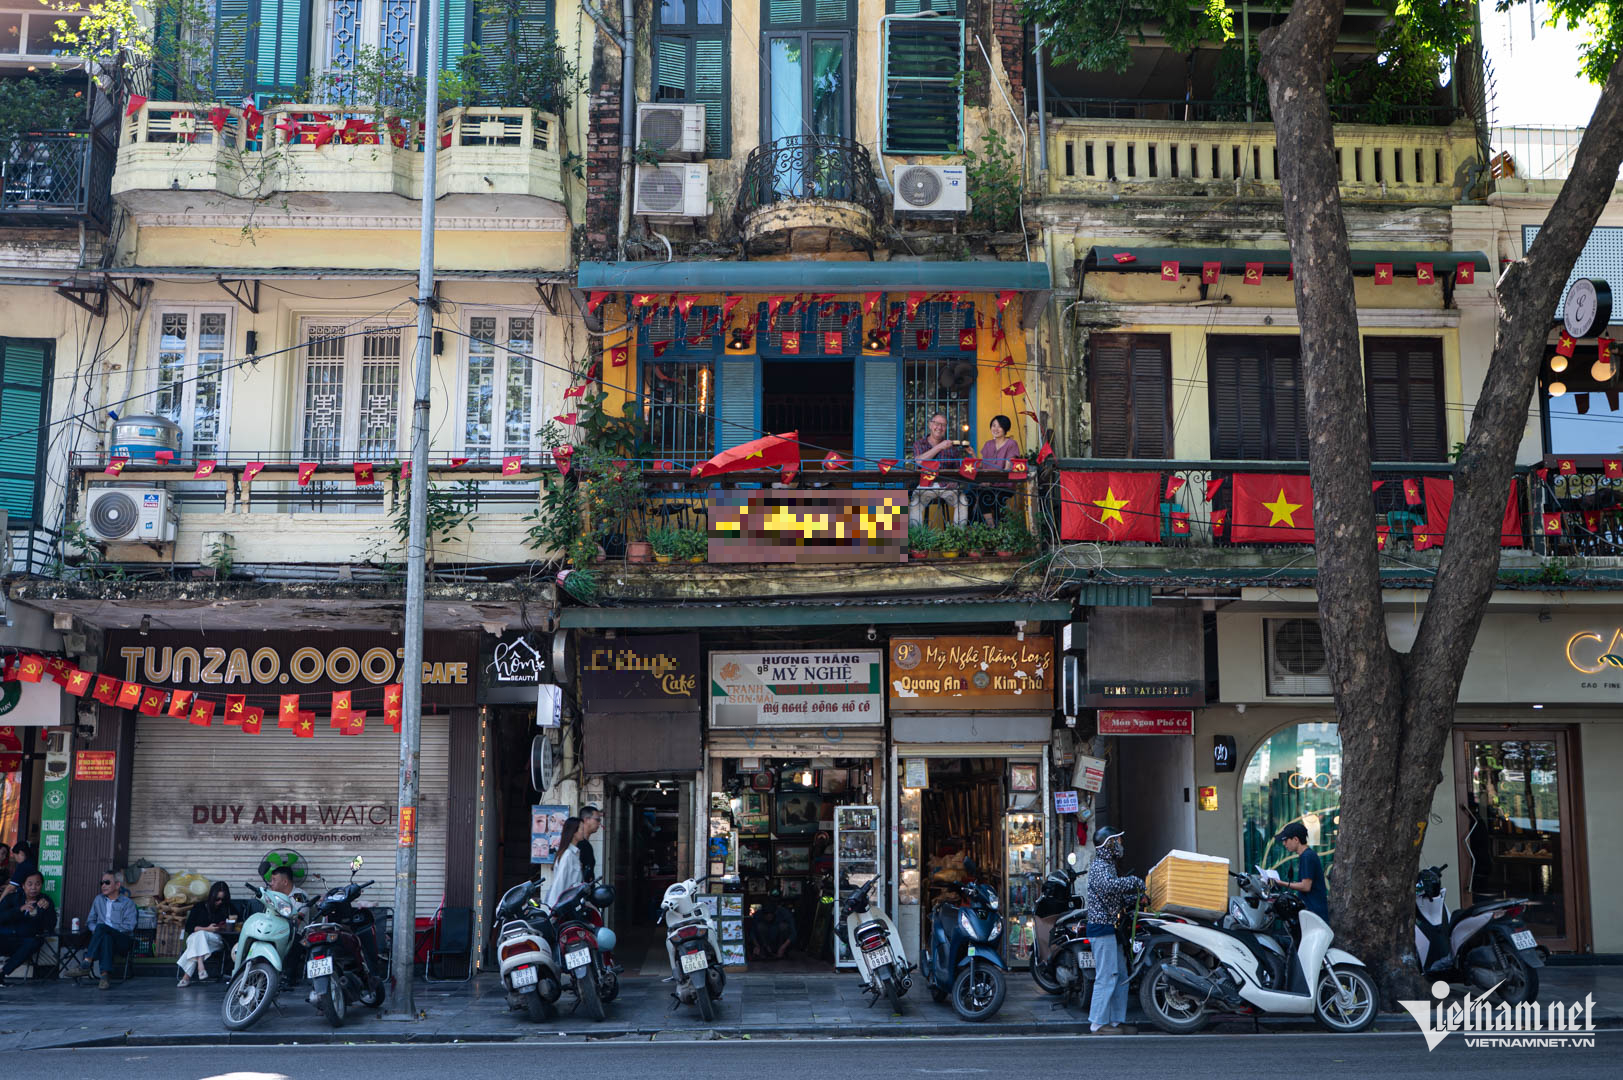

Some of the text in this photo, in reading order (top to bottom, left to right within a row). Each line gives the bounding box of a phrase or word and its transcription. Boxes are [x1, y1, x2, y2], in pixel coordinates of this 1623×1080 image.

[762, 655, 809, 664] HƯƠNG
[926, 646, 946, 670] Mỹ
[949, 646, 979, 671] Nghệ
[983, 645, 1018, 669] Thăng
[1021, 645, 1050, 669] Long
[421, 662, 468, 684] CAFE
[804, 663, 852, 683] NGHỆ
[662, 674, 696, 696] Café
[902, 677, 940, 693] Quang
[994, 676, 1016, 690] Kim
[1112, 718, 1131, 726] Món
[1133, 719, 1154, 727] Ngon
[193, 805, 244, 824] DUY
[252, 805, 307, 824] ANH
[233, 833, 362, 844] www.donghoduyanh.com
